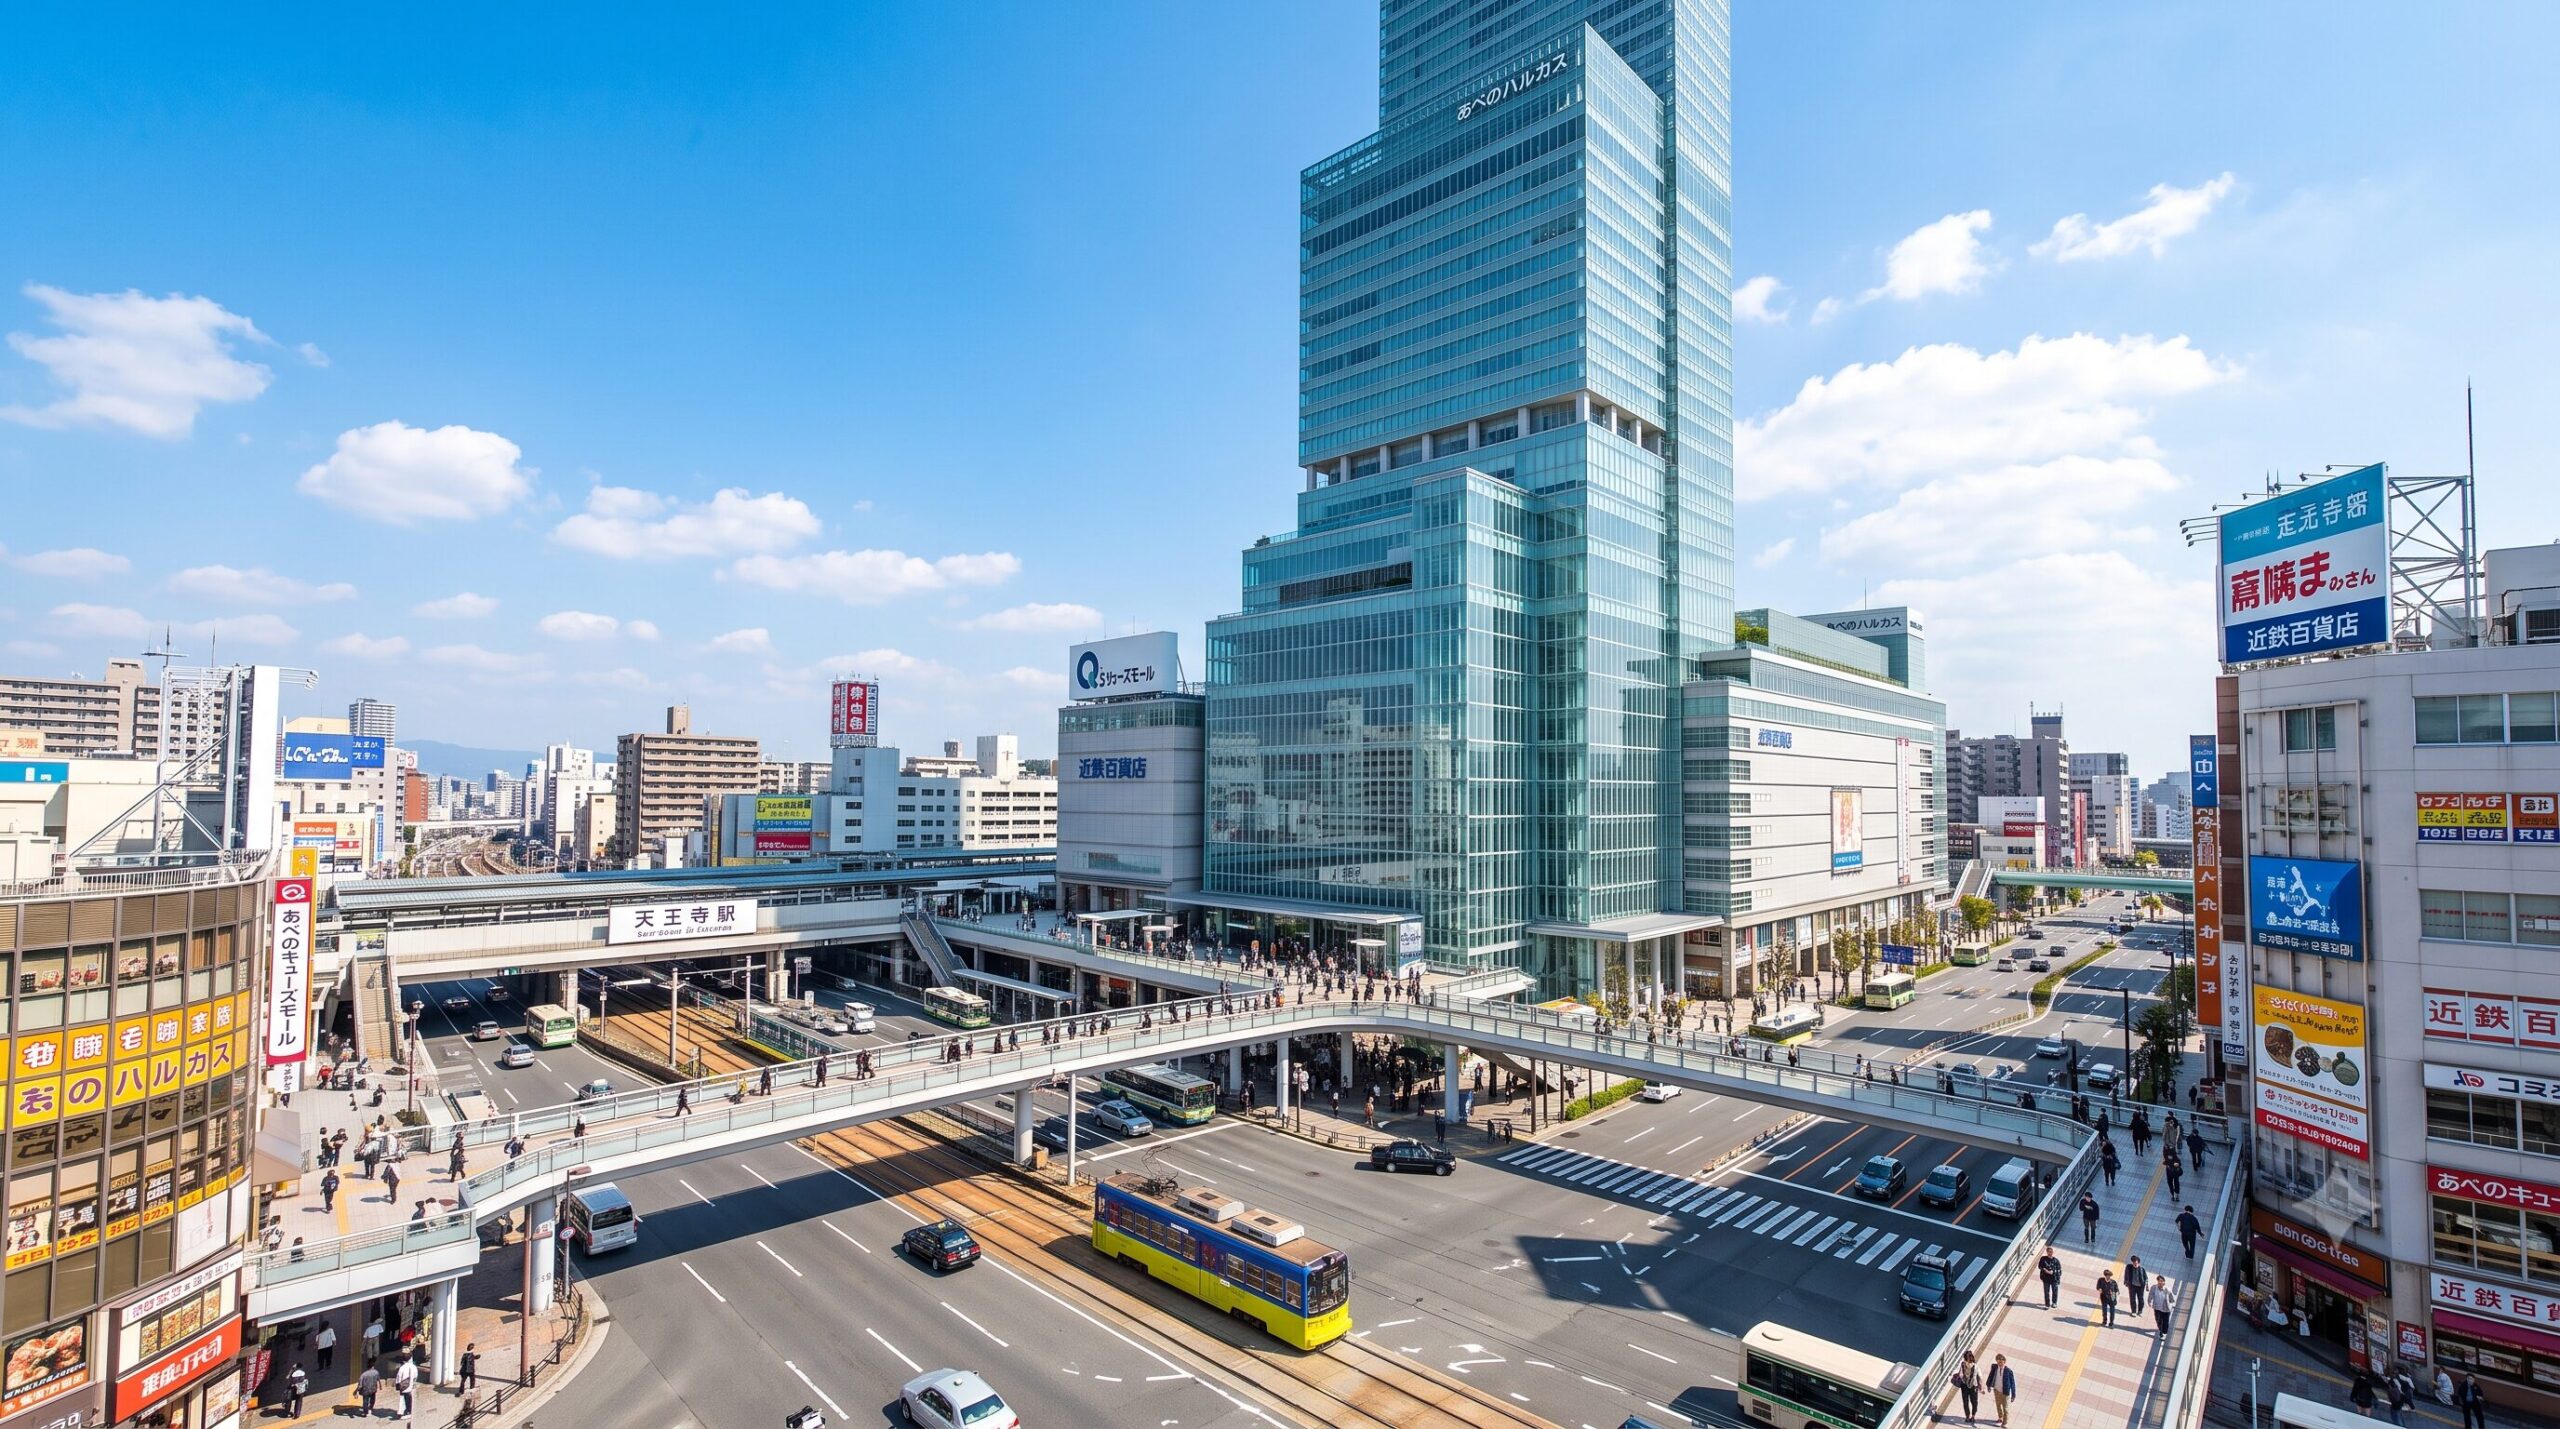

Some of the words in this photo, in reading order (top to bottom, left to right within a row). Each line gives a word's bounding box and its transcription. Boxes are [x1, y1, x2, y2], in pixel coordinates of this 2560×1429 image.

[2247, 611, 2359, 652] 近鉄百貨店
[1079, 757, 1147, 779] 近鉄百貨店
[635, 905, 735, 928] 天王寺駅
[278, 909, 301, 1046] あべのキューズモール
[2428, 1000, 2558, 1036] 近鉄百
